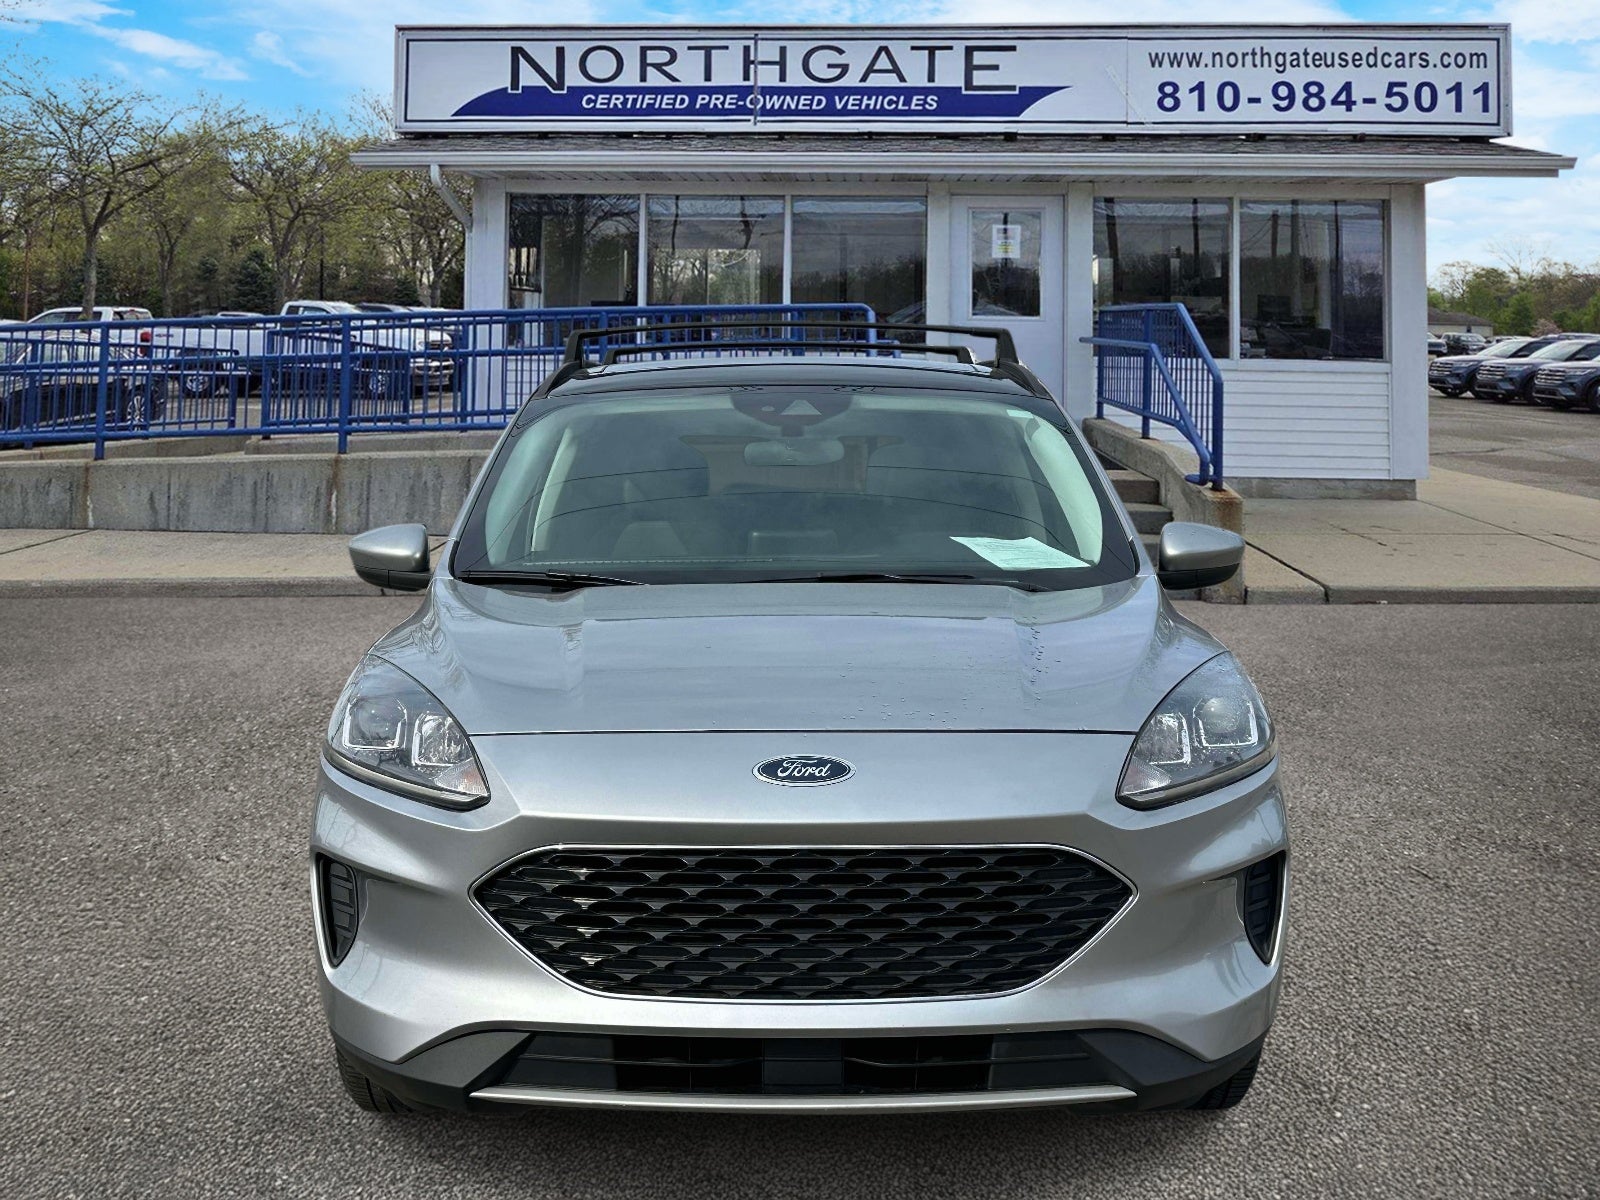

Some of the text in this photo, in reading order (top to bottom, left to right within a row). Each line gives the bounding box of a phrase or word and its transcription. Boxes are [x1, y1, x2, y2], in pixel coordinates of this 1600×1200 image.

[510, 45, 1017, 92] NORTHGATE
[1149, 46, 1487, 73] www.northgateusedcars.com
[581, 93, 938, 110] CERTIFIED PRE-OWNED VEHICLES
[1156, 81, 1490, 113] 810-984-5011
[777, 759, 831, 777] Ford
